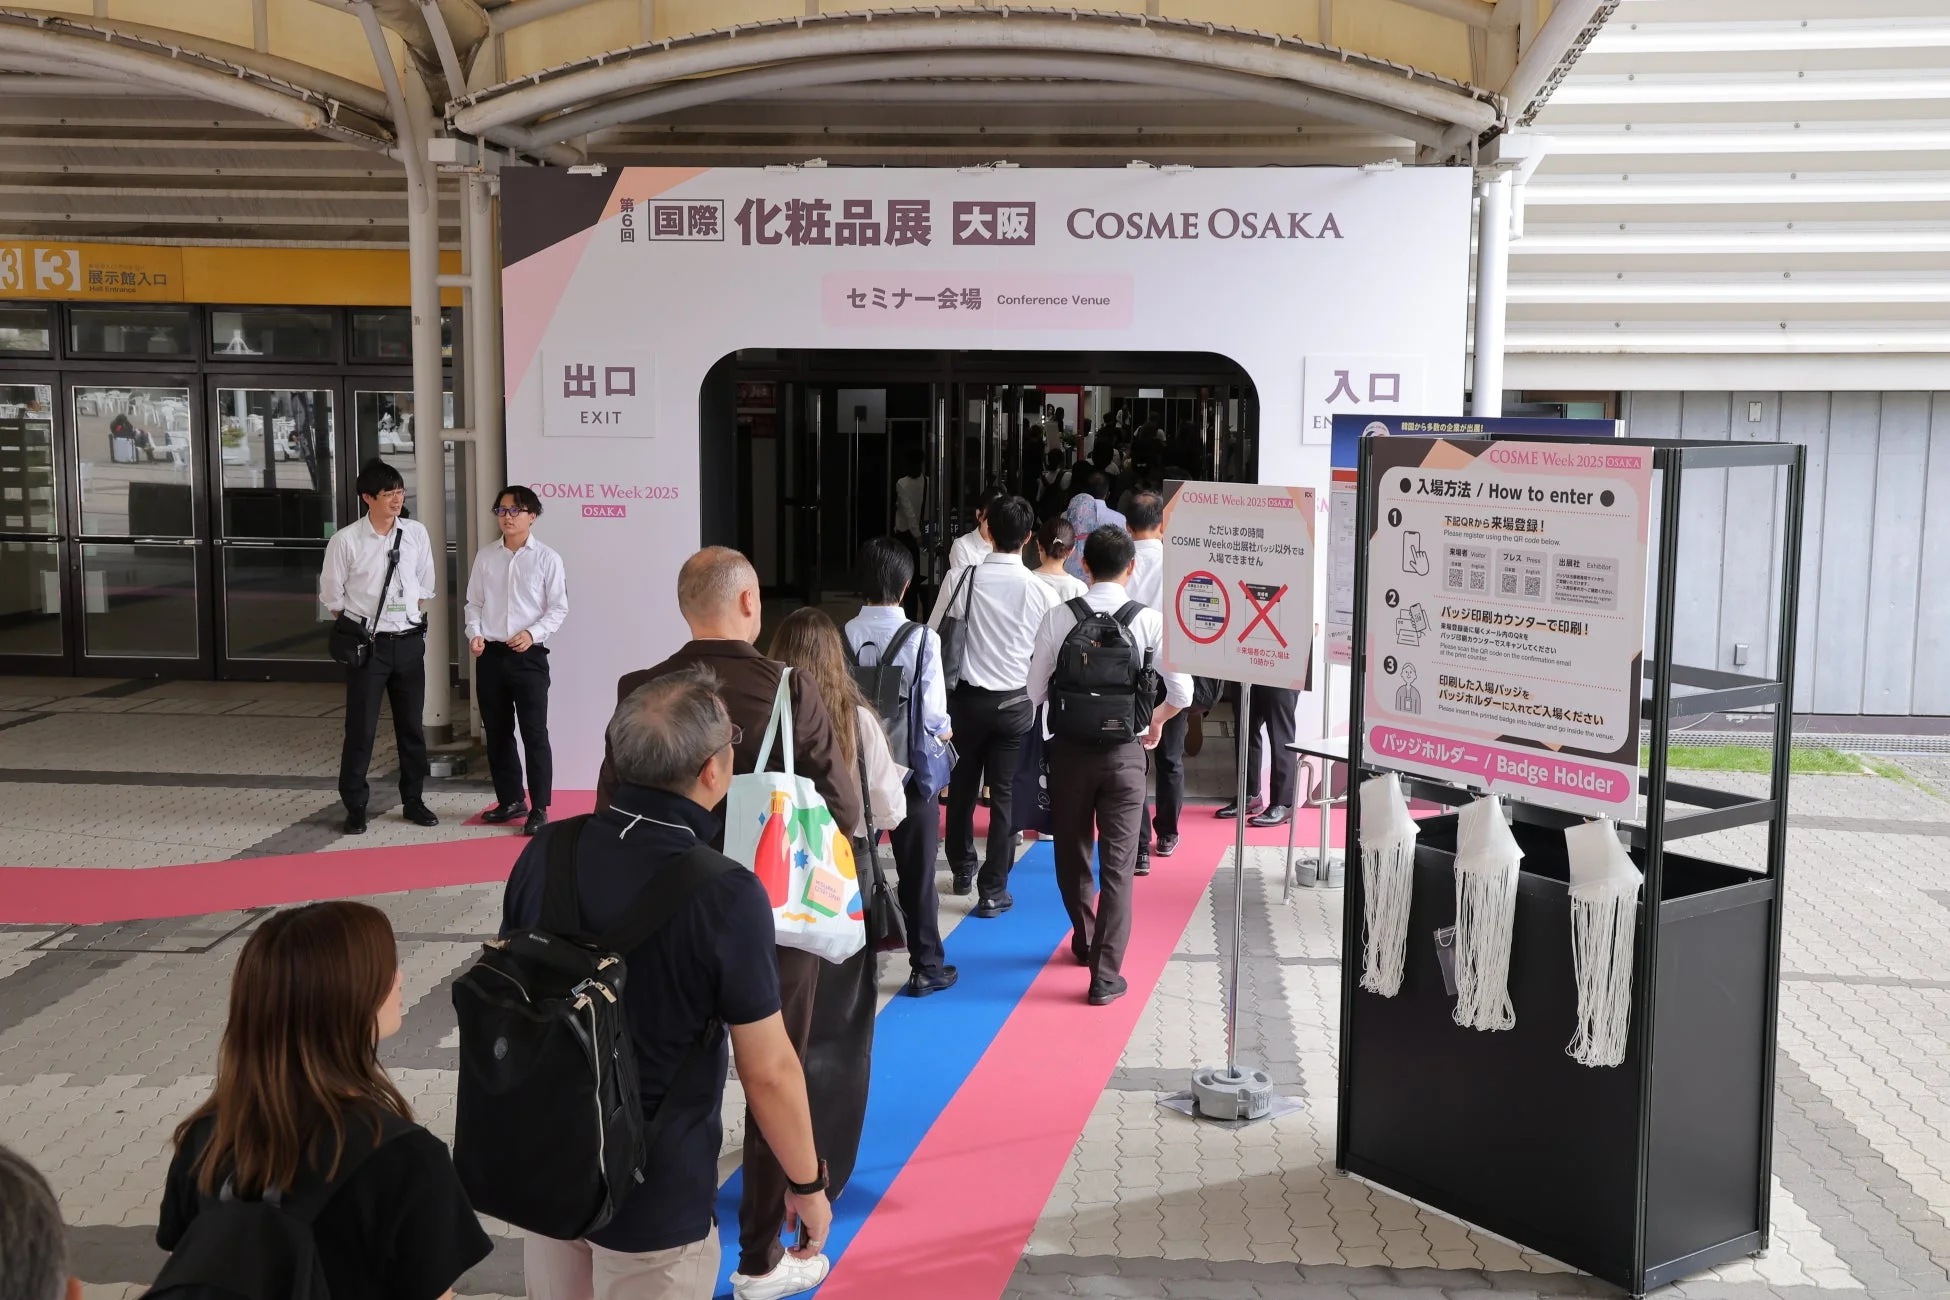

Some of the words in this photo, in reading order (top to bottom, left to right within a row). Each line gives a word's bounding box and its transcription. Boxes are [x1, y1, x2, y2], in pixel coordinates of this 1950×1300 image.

[620, 198, 635, 243] 第6回
[654, 205, 719, 237] 国際
[734, 198, 932, 247] 化粧品展
[959, 206, 1028, 240] 大阪
[1066, 208, 1199, 240] COSME
[1208, 208, 1344, 240] OSAKA
[2, 250, 19, 290] 3
[42, 249, 74, 291] 3
[88, 269, 167, 286] 展示館入口
[846, 287, 982, 310] セミナー会場
[997, 294, 1068, 306] Conference
[1072, 294, 1110, 306] Venue
[563, 363, 636, 398] 出口
[1324, 370, 1401, 404] 入口
[580, 411, 622, 424] EXIT
[1489, 449, 1538, 465] COSME
[1542, 452, 1574, 467] Week
[1576, 455, 1604, 468] 2025
[1606, 457, 1640, 468] OSAKA
[600, 484, 642, 499] Week
[645, 486, 679, 499] 2025
[1182, 492, 1219, 505] COSME
[1222, 494, 1245, 506] Week
[1246, 497, 1267, 508] 2025
[1416, 478, 1472, 499] 入場方法
[1489, 483, 1523, 500] How
[1528, 486, 1544, 502] to
[1550, 488, 1594, 505] enter
[583, 506, 625, 517] OSAKA
[1171, 536, 1200, 547] COSME
[1208, 524, 1265, 539] ただいまの時間
[1443, 529, 1461, 537] Please
[1486, 533, 1501, 541] using
[1524, 536, 1539, 544] code
[1208, 552, 1264, 567] 入場できません
[1441, 606, 1589, 636] バッジ印刷カウンターで印刷！
[1439, 674, 1530, 700] 印刷した入場バッジを
[1438, 689, 1604, 726] バッジホルダーに入れてご入場ください
[1438, 704, 1455, 713] Please
[1528, 720, 1546, 730] holder
[1382, 733, 1479, 764] バッジホルダー
[1496, 755, 1549, 785] Badge
[1553, 765, 1614, 795] Holder
